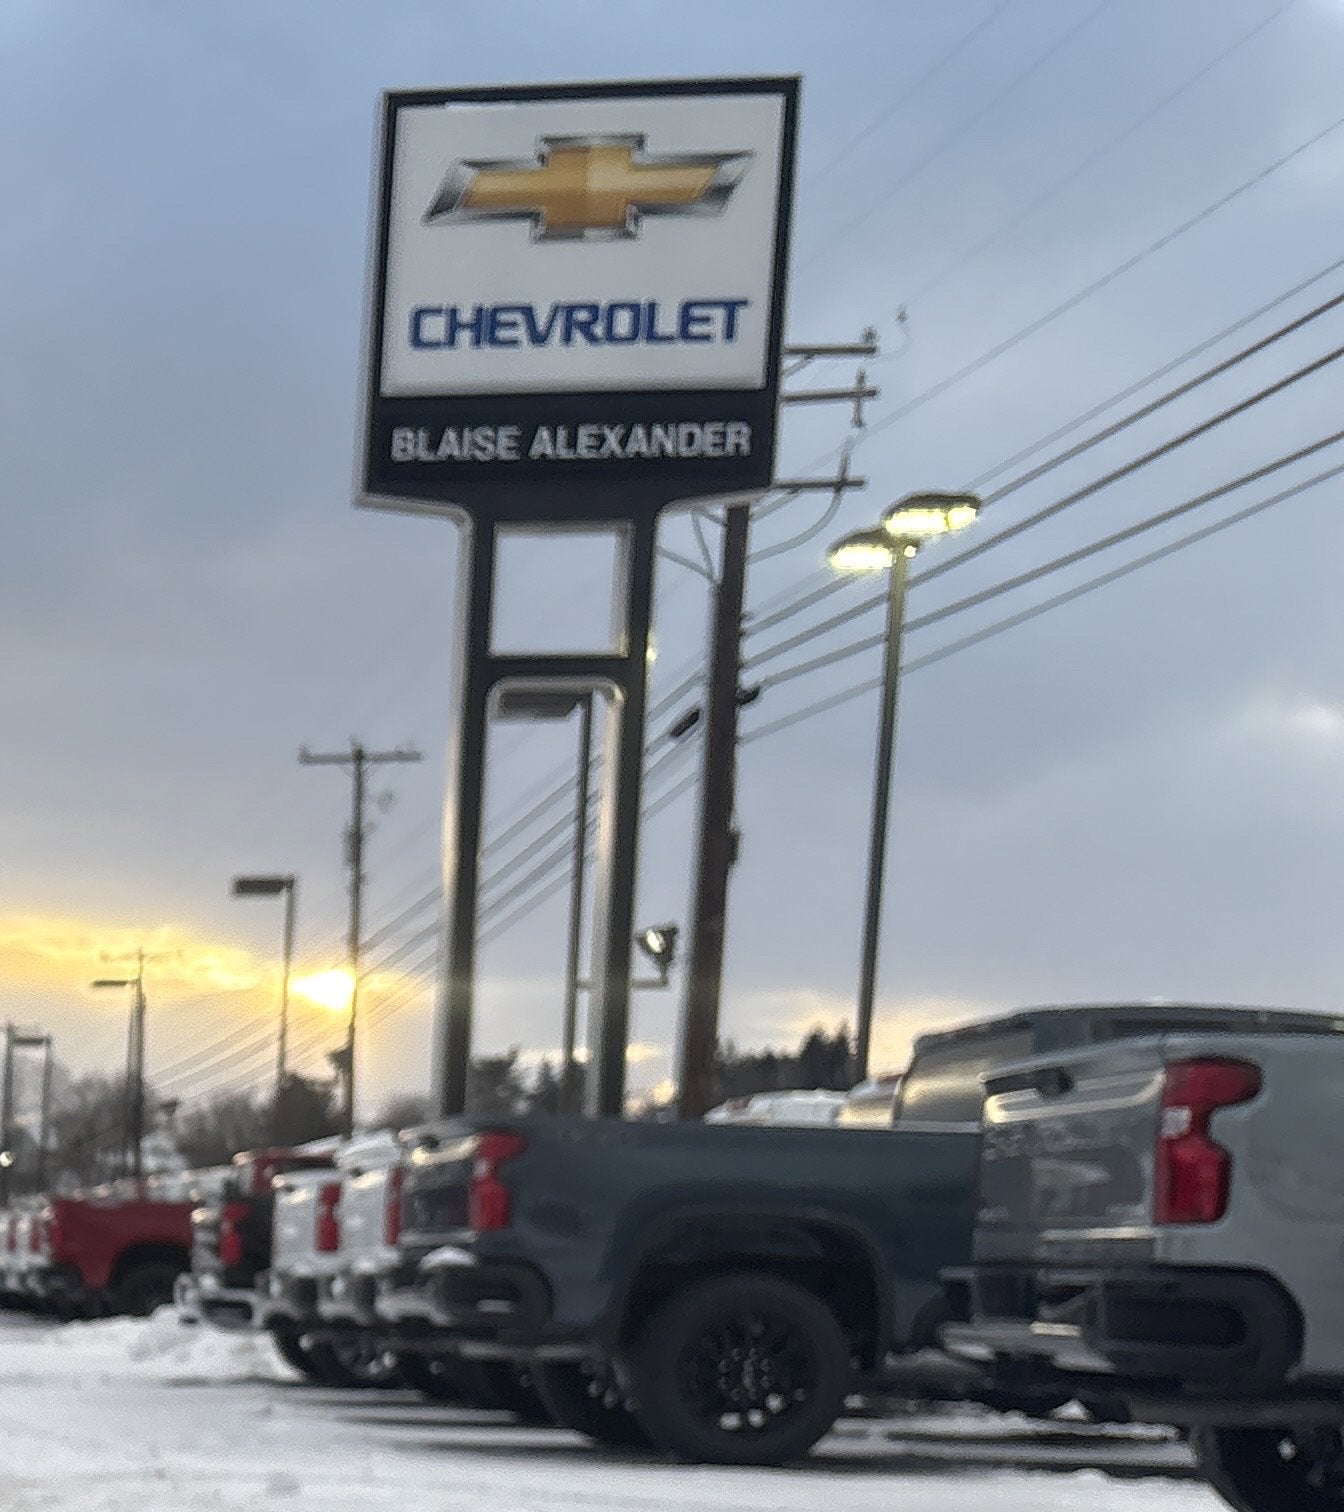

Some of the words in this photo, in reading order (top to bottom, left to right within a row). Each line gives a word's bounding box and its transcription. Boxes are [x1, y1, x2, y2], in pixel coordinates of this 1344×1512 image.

[411, 299, 749, 349] CHEVROLET
[391, 424, 521, 462] BLAISE
[528, 420, 753, 460] ALEXANDER
